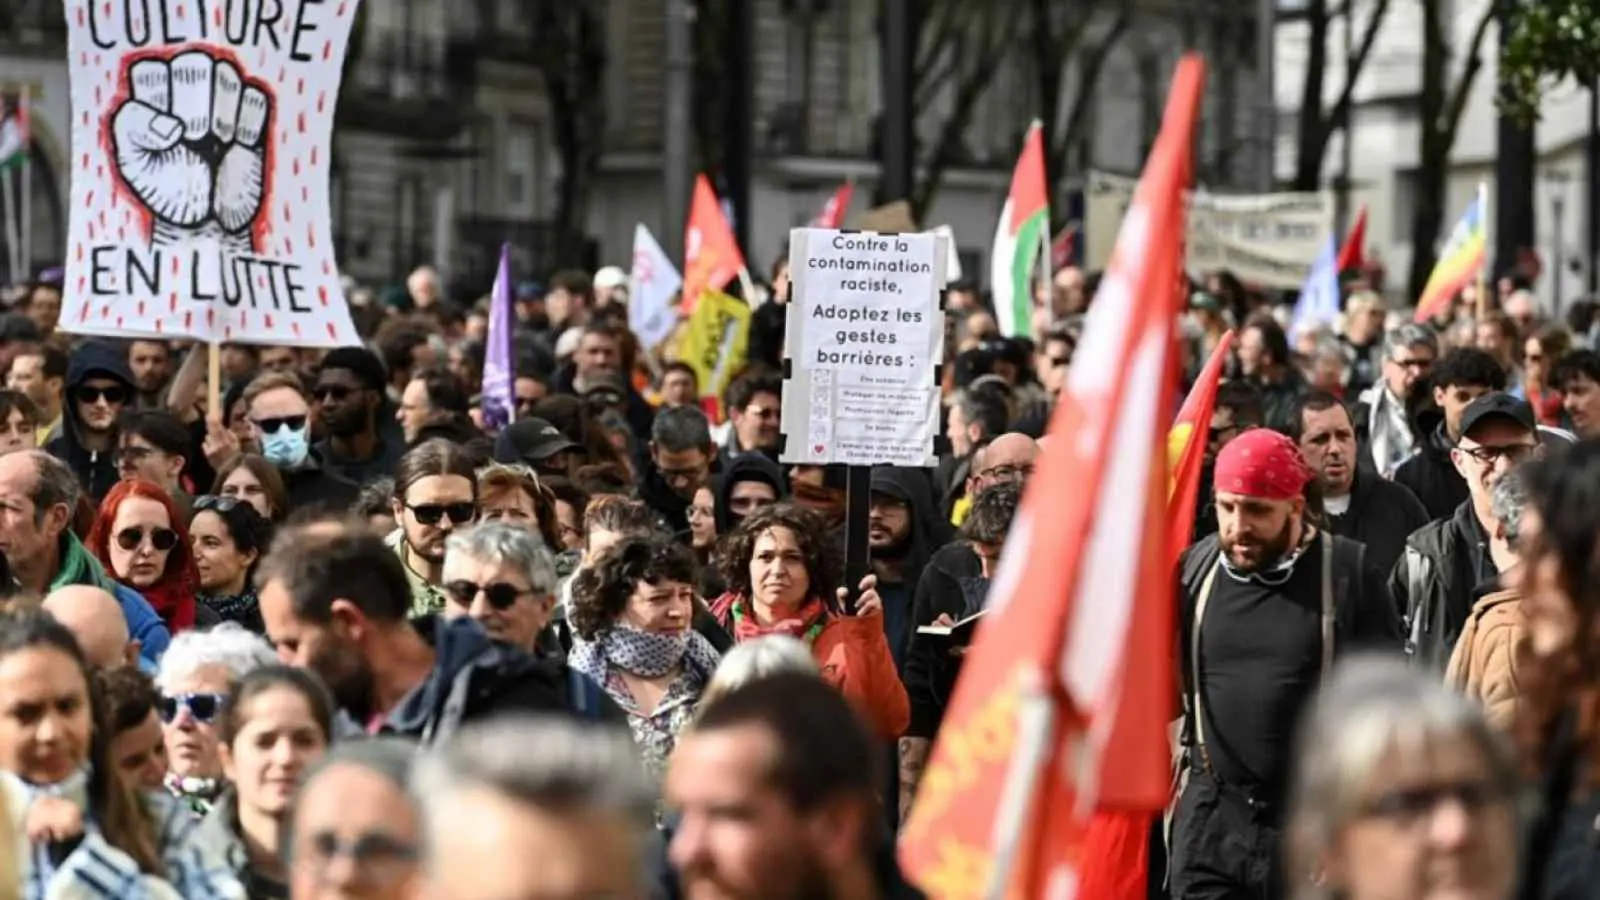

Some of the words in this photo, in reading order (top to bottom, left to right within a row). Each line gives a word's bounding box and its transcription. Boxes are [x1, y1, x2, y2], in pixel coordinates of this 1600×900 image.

[832, 236, 888, 251] Contre
[894, 238, 909, 252] la
[808, 257, 931, 273] contamination
[91, 245, 161, 296] EN
[191, 249, 312, 313] LUTTE
[840, 278, 903, 294] raciste,
[812, 304, 889, 322] Adoptez
[896, 308, 922, 323] les
[835, 329, 897, 345] gestes
[817, 349, 903, 367] barrières
